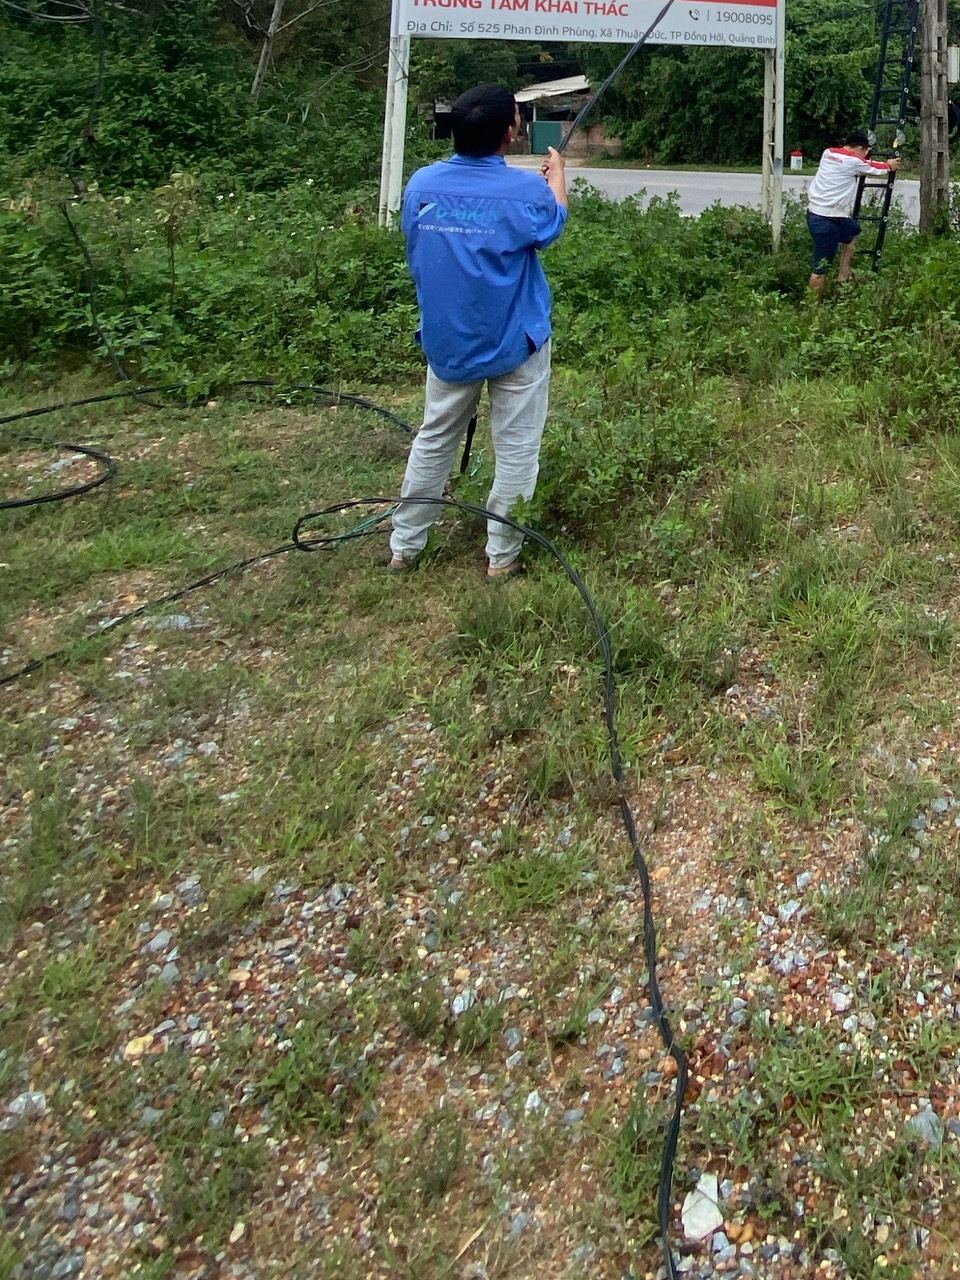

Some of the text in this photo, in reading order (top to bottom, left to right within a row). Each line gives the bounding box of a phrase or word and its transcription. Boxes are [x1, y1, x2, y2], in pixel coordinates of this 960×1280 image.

[583, 0, 629, 16] THÁC
[716, 11, 773, 25] 19008095
[407, 21, 427, 32] Địa
[459, 21, 476, 32] Số
[478, 23, 500, 33] 525
[503, 24, 531, 35] Phan
[535, 25, 559, 36] Đình
[670, 31, 682, 40] TP
